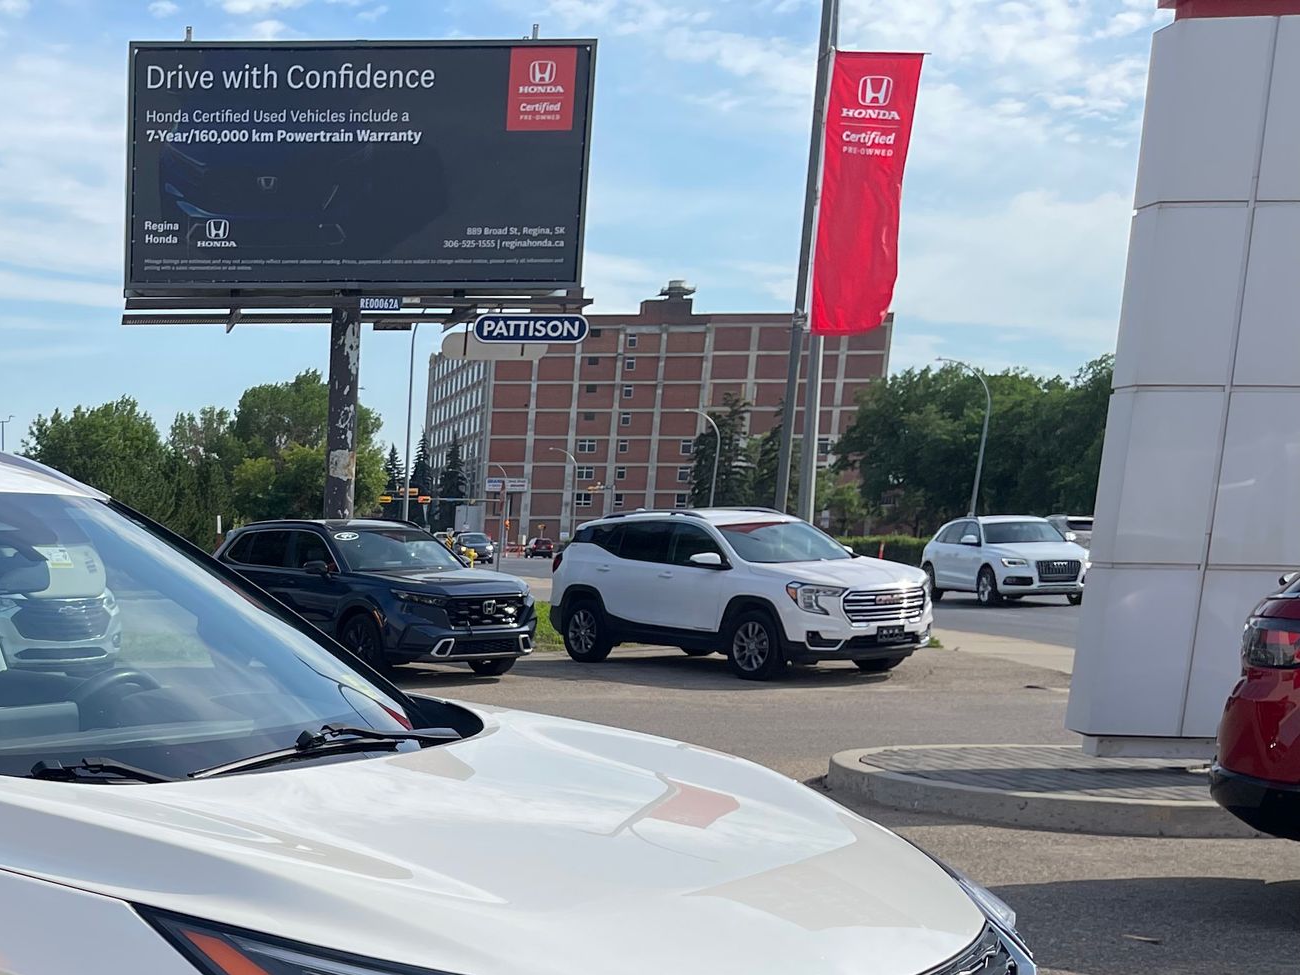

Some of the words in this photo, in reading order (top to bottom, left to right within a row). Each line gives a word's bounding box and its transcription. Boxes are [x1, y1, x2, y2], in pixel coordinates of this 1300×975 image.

[147, 64, 214, 89] Drive
[222, 63, 278, 89] with
[287, 62, 435, 89] Confidence
[518, 85, 564, 94] HONDA
[520, 102, 561, 113] Certified
[146, 109, 189, 123] Honda
[192, 109, 249, 123] Certified
[253, 109, 286, 123] Used
[290, 109, 346, 123] Vehicles
[349, 108, 398, 122] include
[401, 111, 410, 122] a
[841, 108, 900, 120] HONDA
[146, 129, 249, 144] 7-Year/160,000
[251, 129, 274, 142] km
[277, 129, 354, 142] Powertrain
[356, 129, 422, 144] Warranty
[842, 131, 895, 146] Certified
[842, 146, 893, 156] PRE-OWNED
[144, 221, 179, 233] Regina
[466, 227, 482, 235] 889
[483, 226, 507, 235] Broad
[522, 226, 553, 237] Regina,
[554, 226, 566, 234] SK
[145, 234, 178, 244] Honda
[197, 240, 237, 248] HONDA
[443, 239, 496, 248] 306-525-1555
[501, 238, 565, 250] reginahonda.ca
[360, 298, 399, 309] RE00062A
[482, 320, 580, 337] PATTISON
